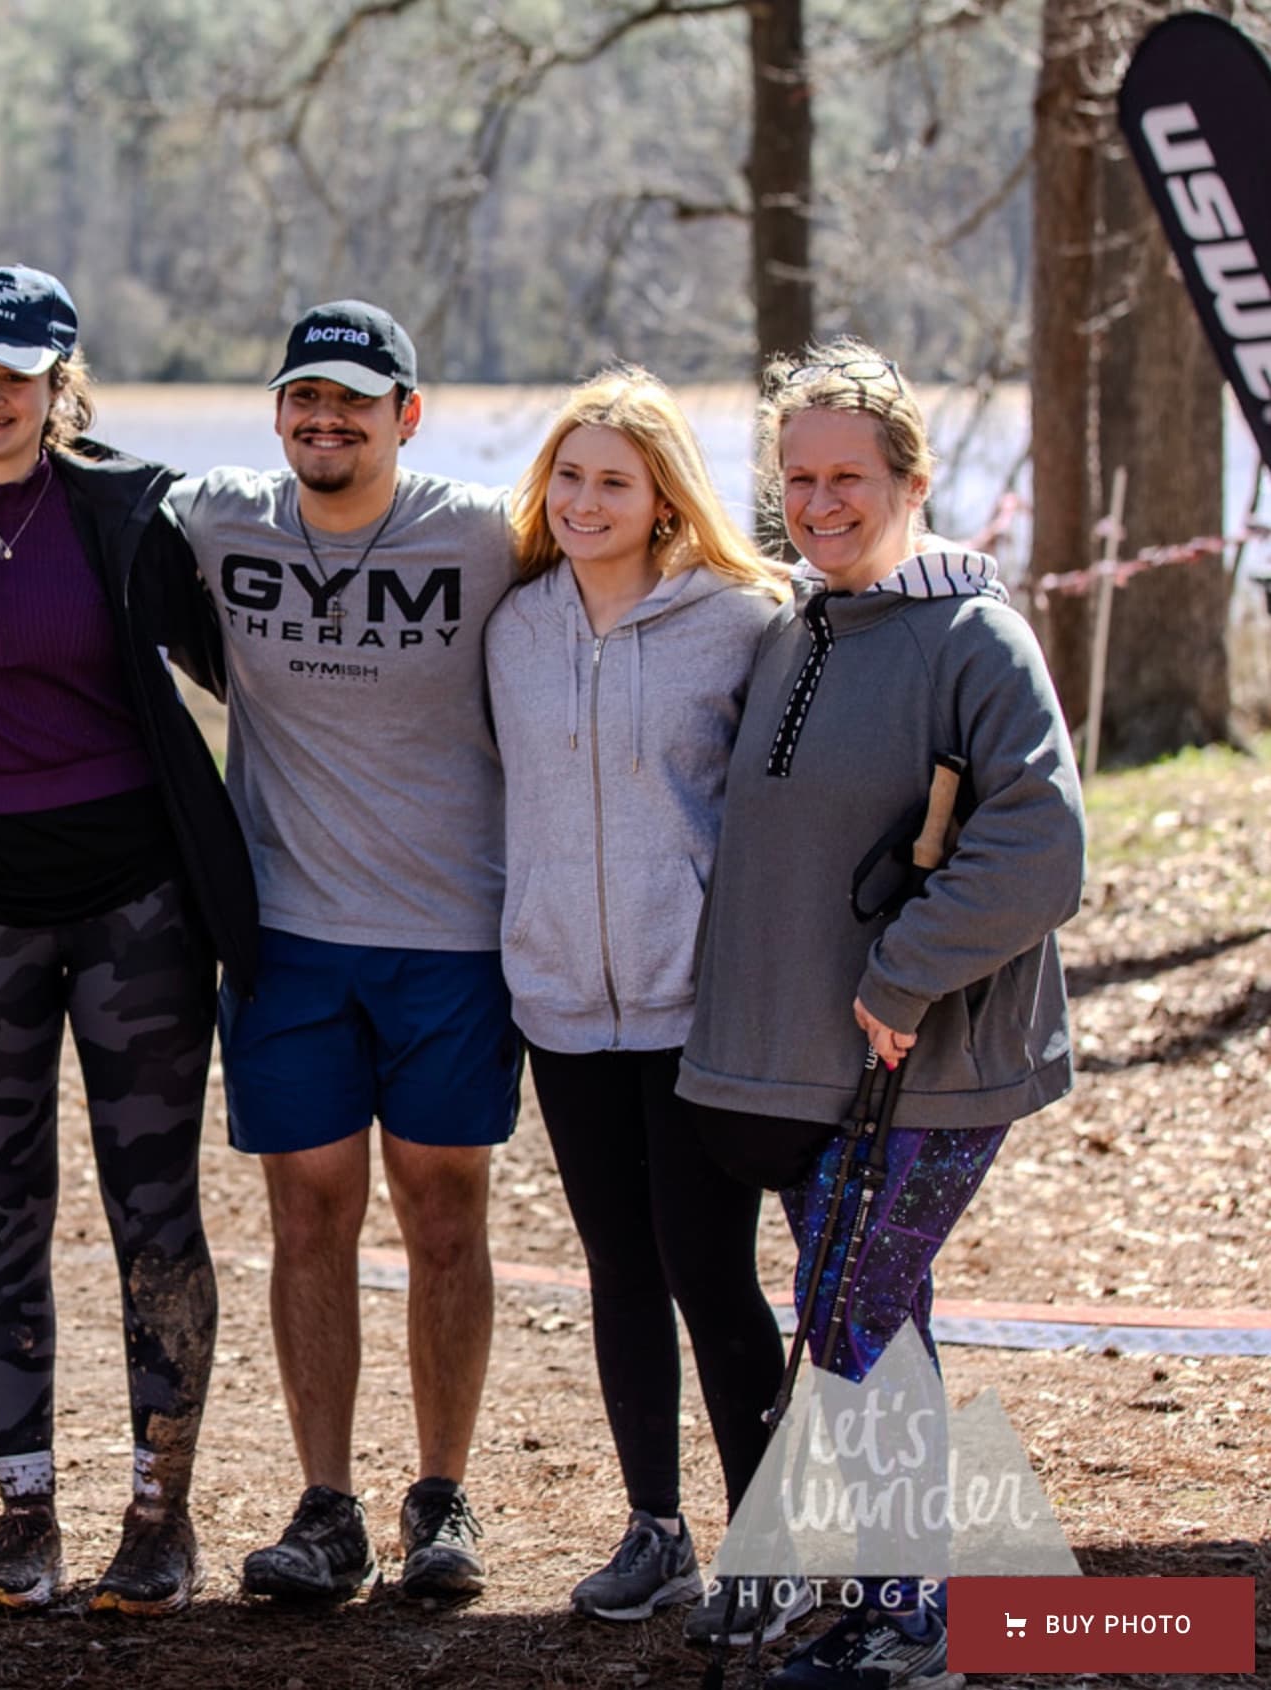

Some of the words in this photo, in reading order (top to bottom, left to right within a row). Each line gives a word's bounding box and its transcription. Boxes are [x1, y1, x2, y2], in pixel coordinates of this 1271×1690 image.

[304, 326, 370, 346] lecrae
[220, 553, 462, 623] GYM
[227, 606, 460, 649] THERAPY
[289, 660, 378, 677] GYMISH
